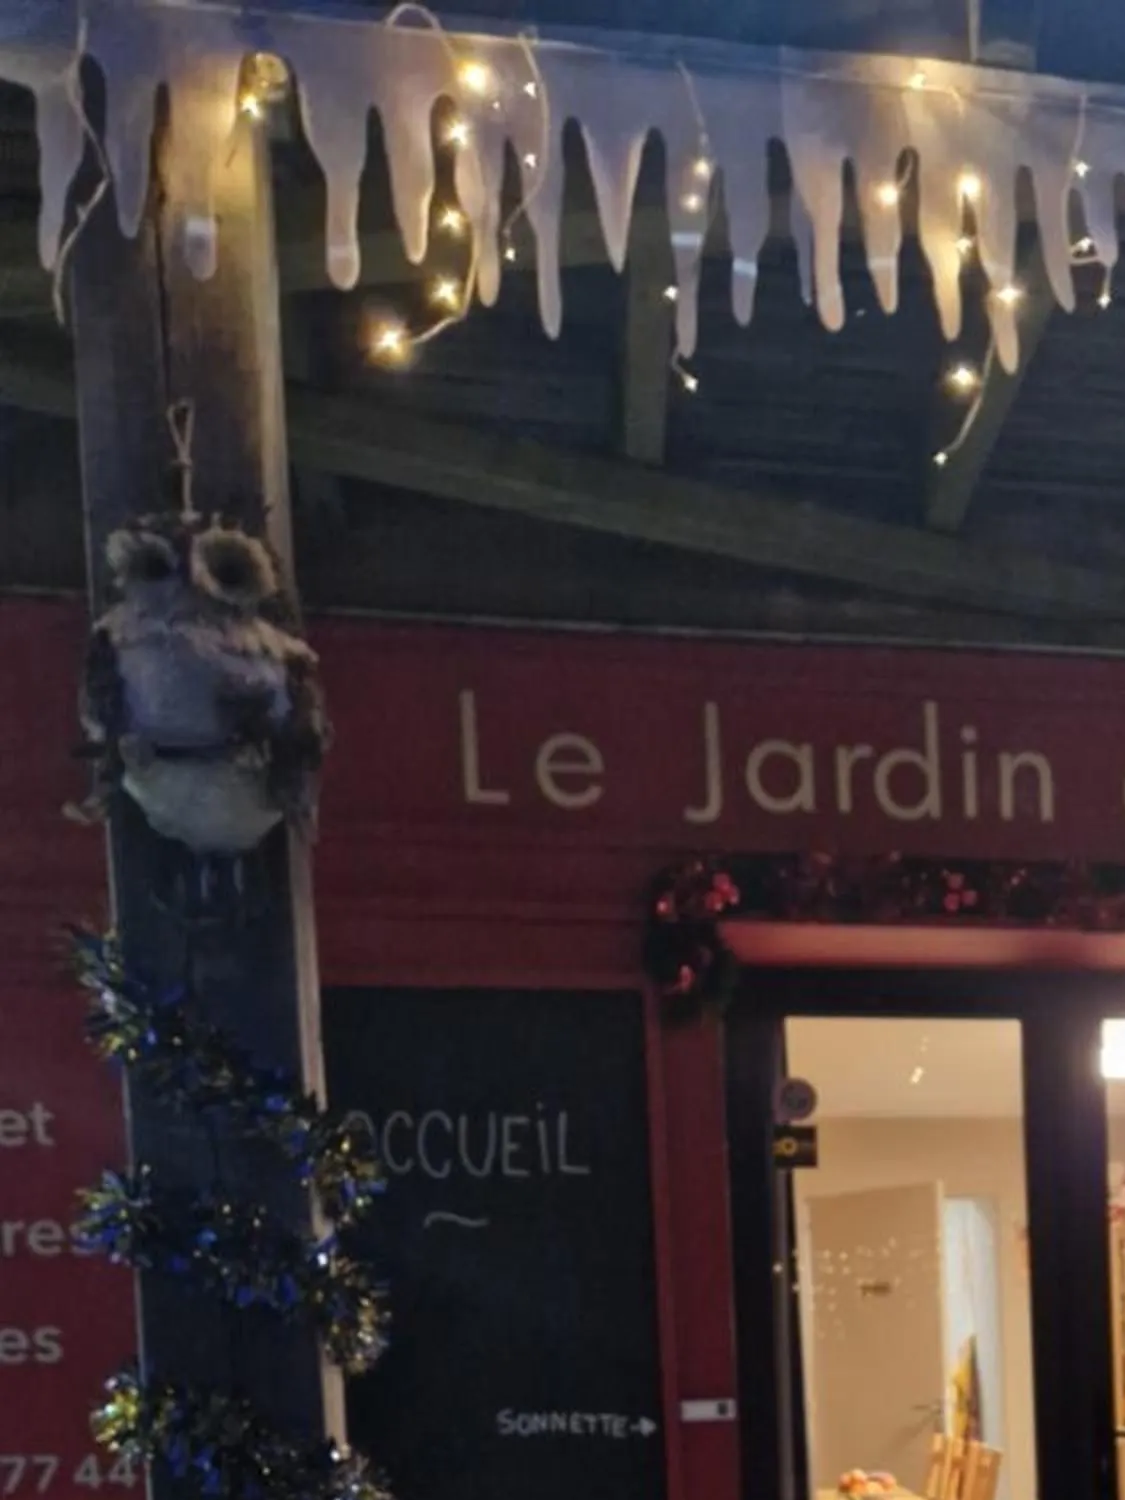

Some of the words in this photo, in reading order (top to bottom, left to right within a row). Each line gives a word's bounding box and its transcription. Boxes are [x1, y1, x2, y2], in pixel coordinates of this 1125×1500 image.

[459, 690, 606, 809] Le
[685, 701, 1055, 824] Jardin
[0, 1101, 54, 1147] et
[0, 1325, 63, 1363] es
[497, 1408, 628, 1437] SONNETTE
[3, 1455, 58, 1494] 77
[73, 1455, 136, 1489] 44
